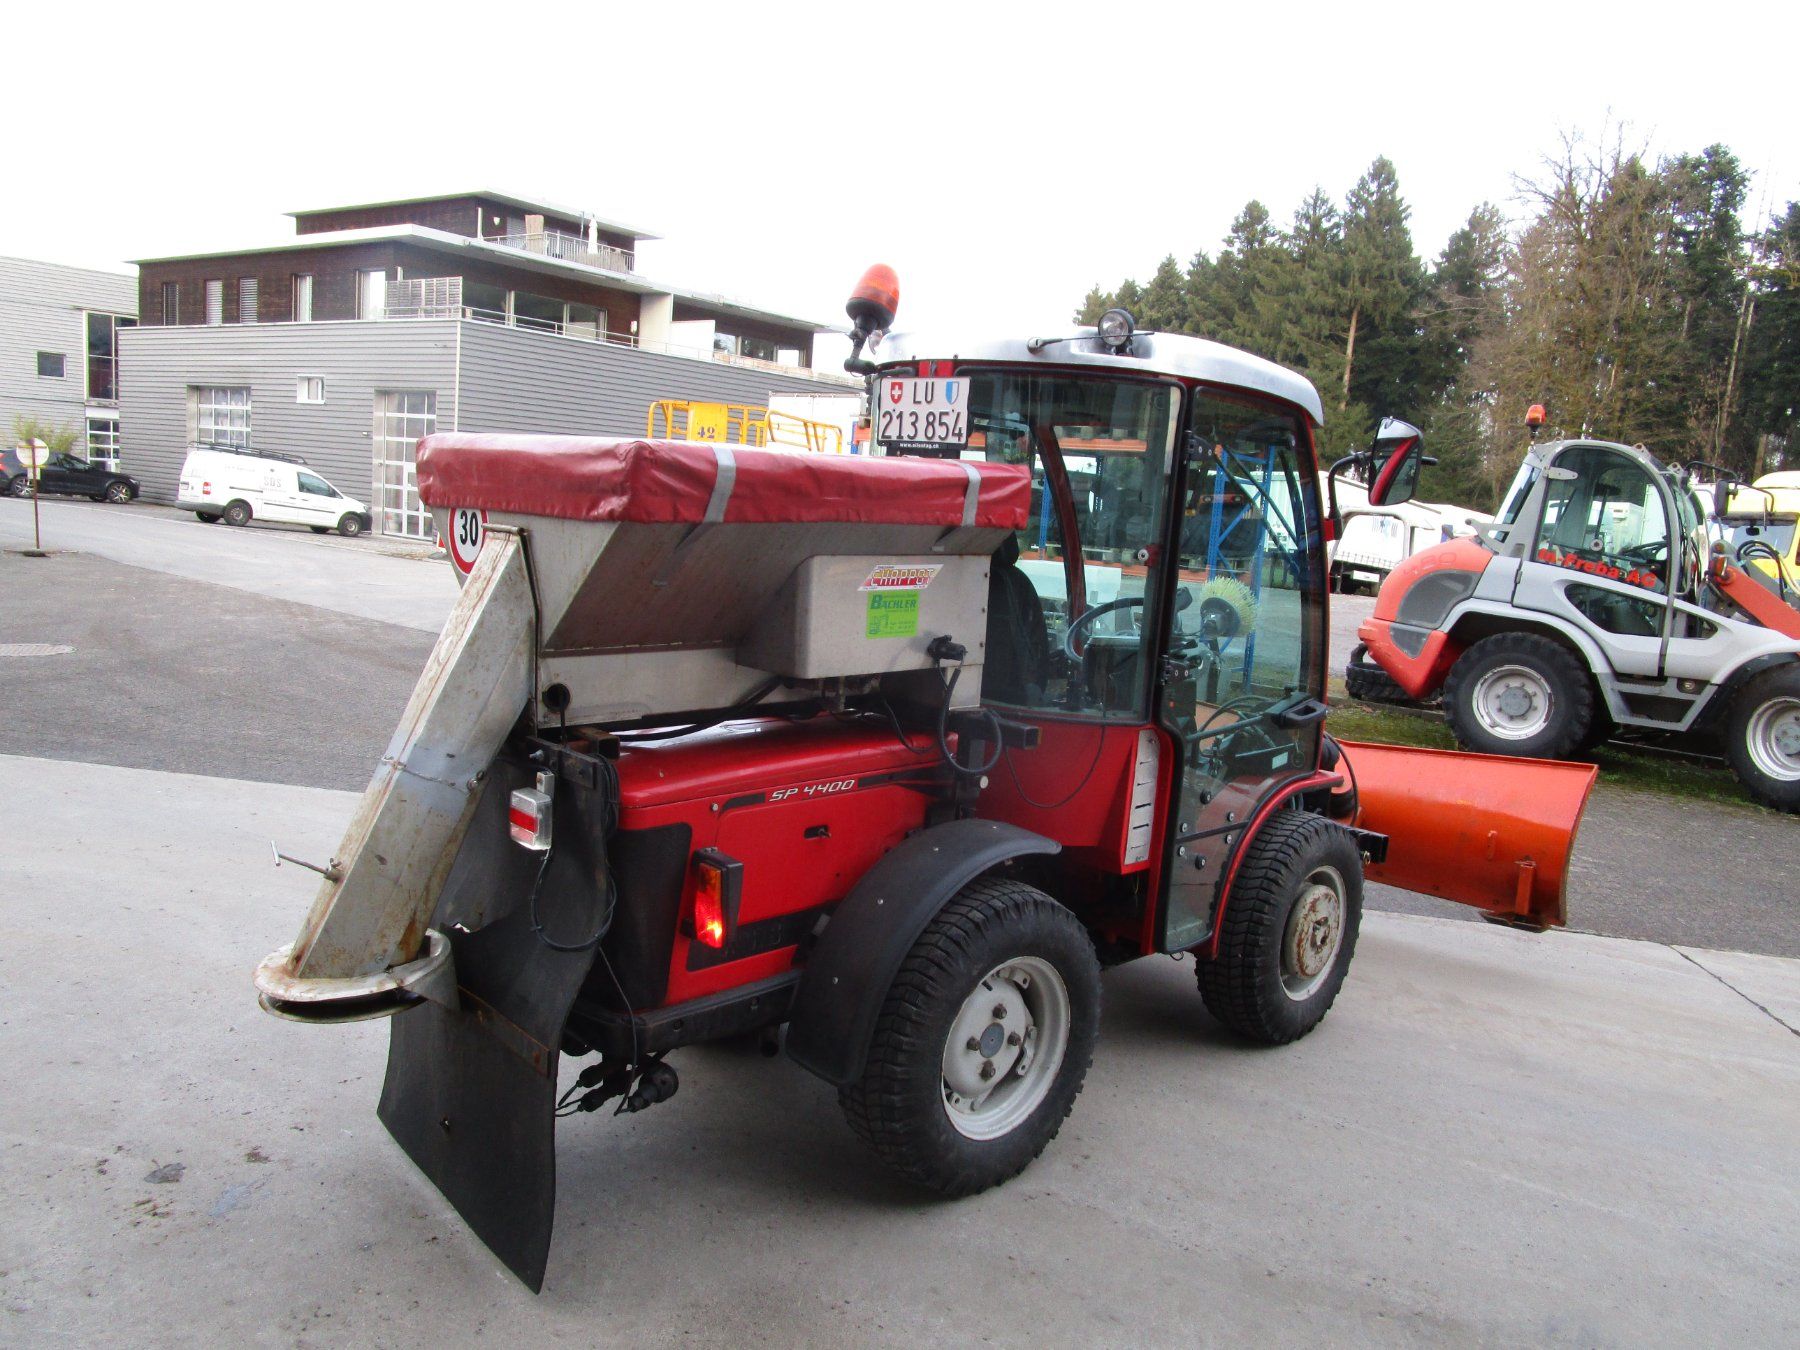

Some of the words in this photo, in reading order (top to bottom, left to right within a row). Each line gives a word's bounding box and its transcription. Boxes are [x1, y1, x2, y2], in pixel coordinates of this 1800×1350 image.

[913, 381, 934, 404] LU
[697, 425, 715, 439] 42
[460, 510, 479, 546] 30
[769, 787, 798, 802] SP
[803, 779, 855, 796] 4400
